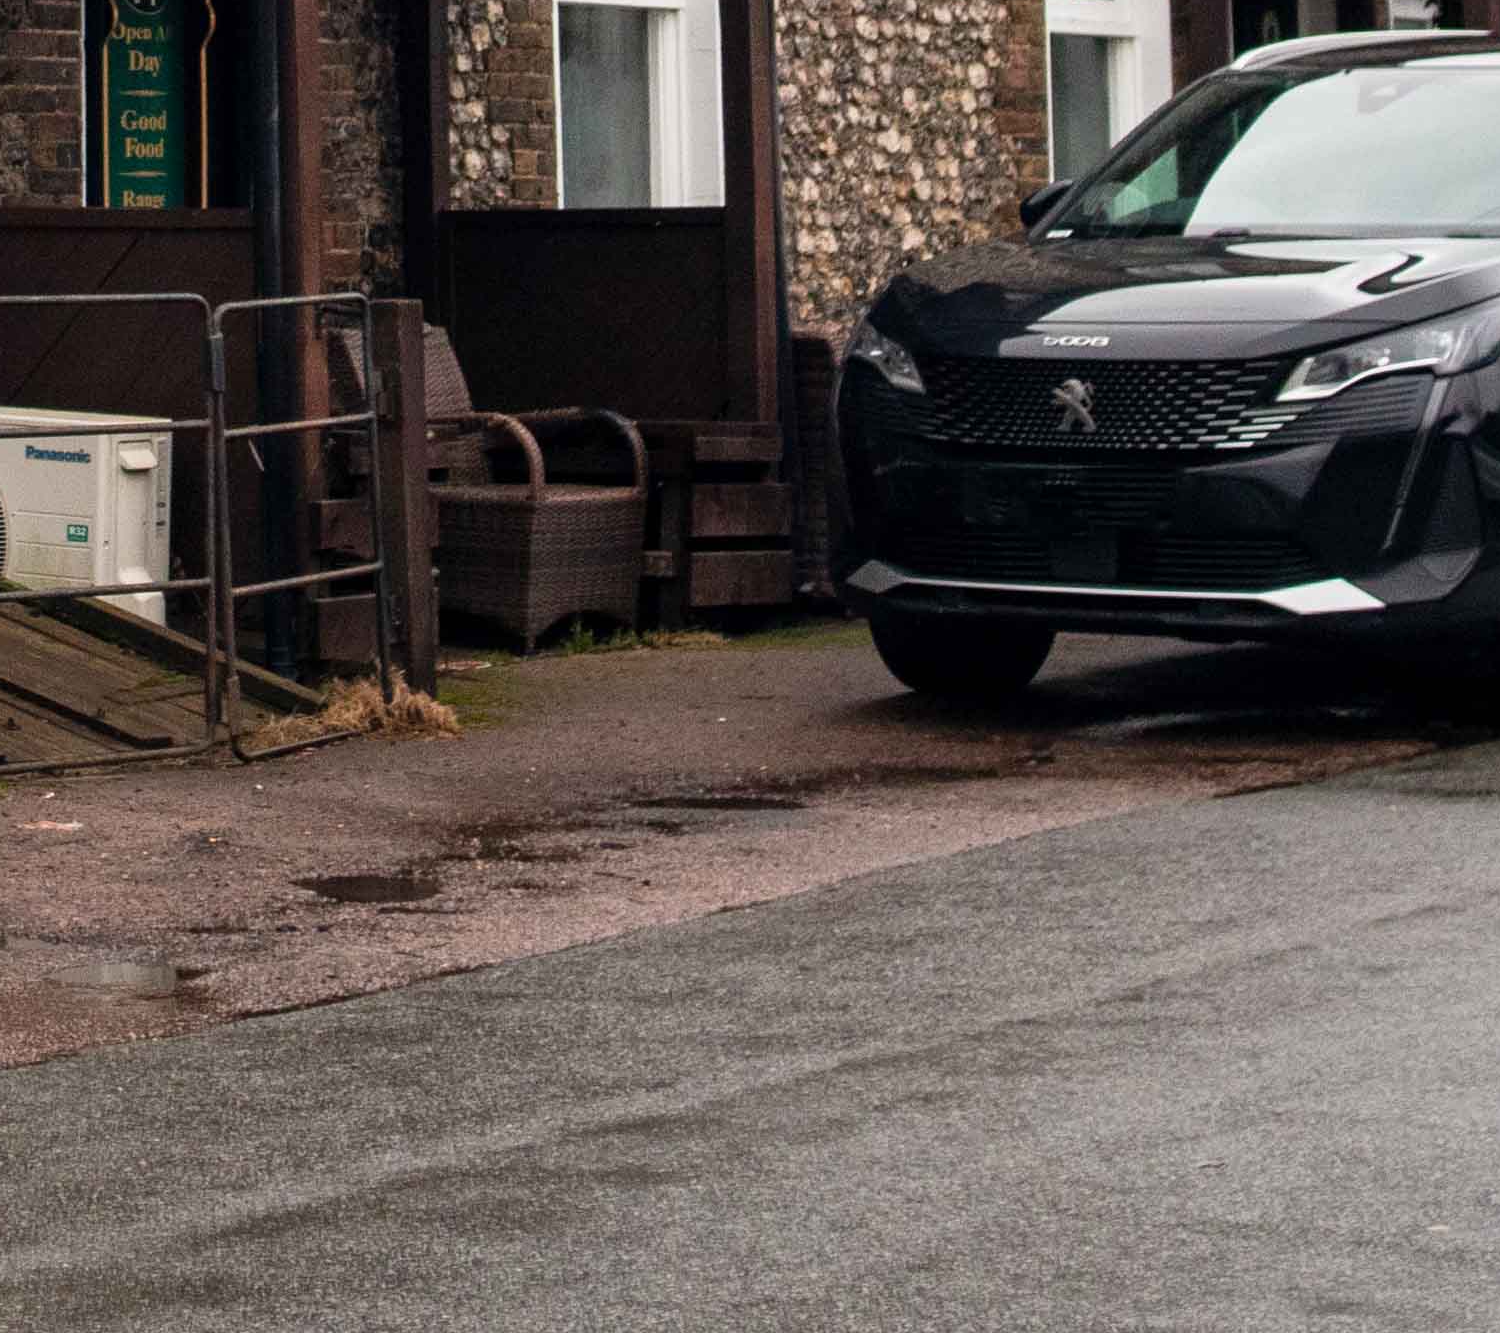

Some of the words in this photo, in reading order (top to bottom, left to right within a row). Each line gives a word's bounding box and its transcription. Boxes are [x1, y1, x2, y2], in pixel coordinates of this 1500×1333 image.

[110, 22, 153, 44] Open
[128, 50, 162, 76] Day
[120, 109, 168, 132] Good
[123, 136, 165, 159] Food
[25, 445, 91, 463] Panasonic
[69, 526, 87, 536] R32
